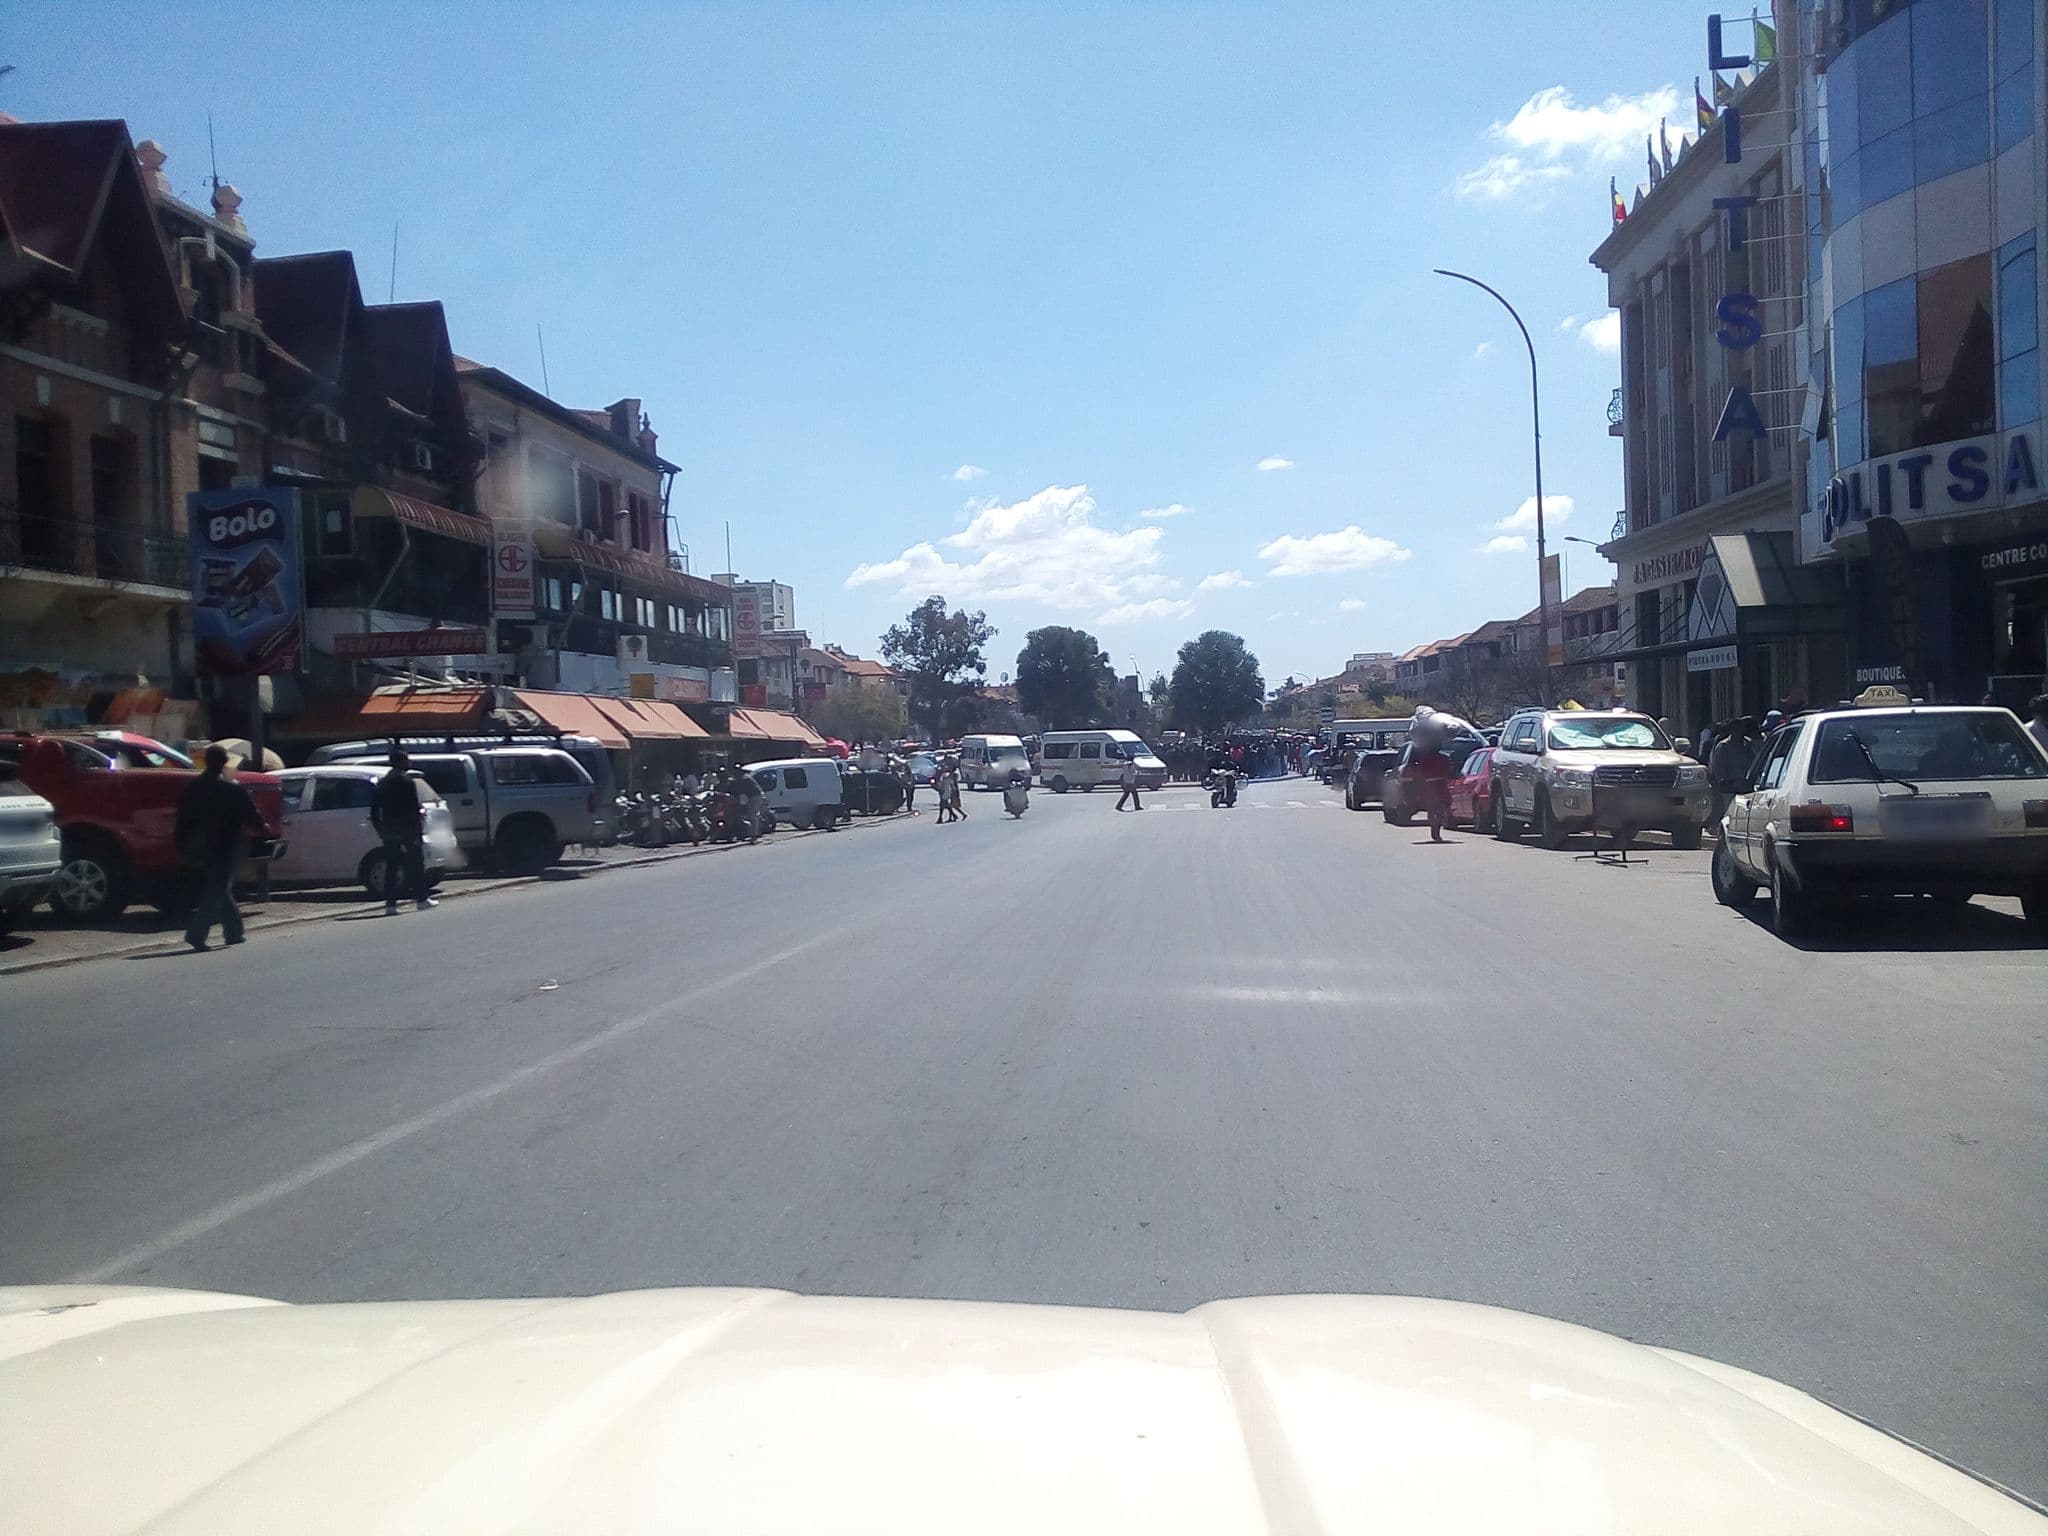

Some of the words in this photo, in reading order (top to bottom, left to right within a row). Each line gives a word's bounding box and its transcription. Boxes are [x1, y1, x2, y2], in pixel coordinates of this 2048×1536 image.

[208, 506, 276, 542] Bolo
[1981, 546, 2027, 568] CENTRE
[1871, 689, 1895, 698] TAXI
